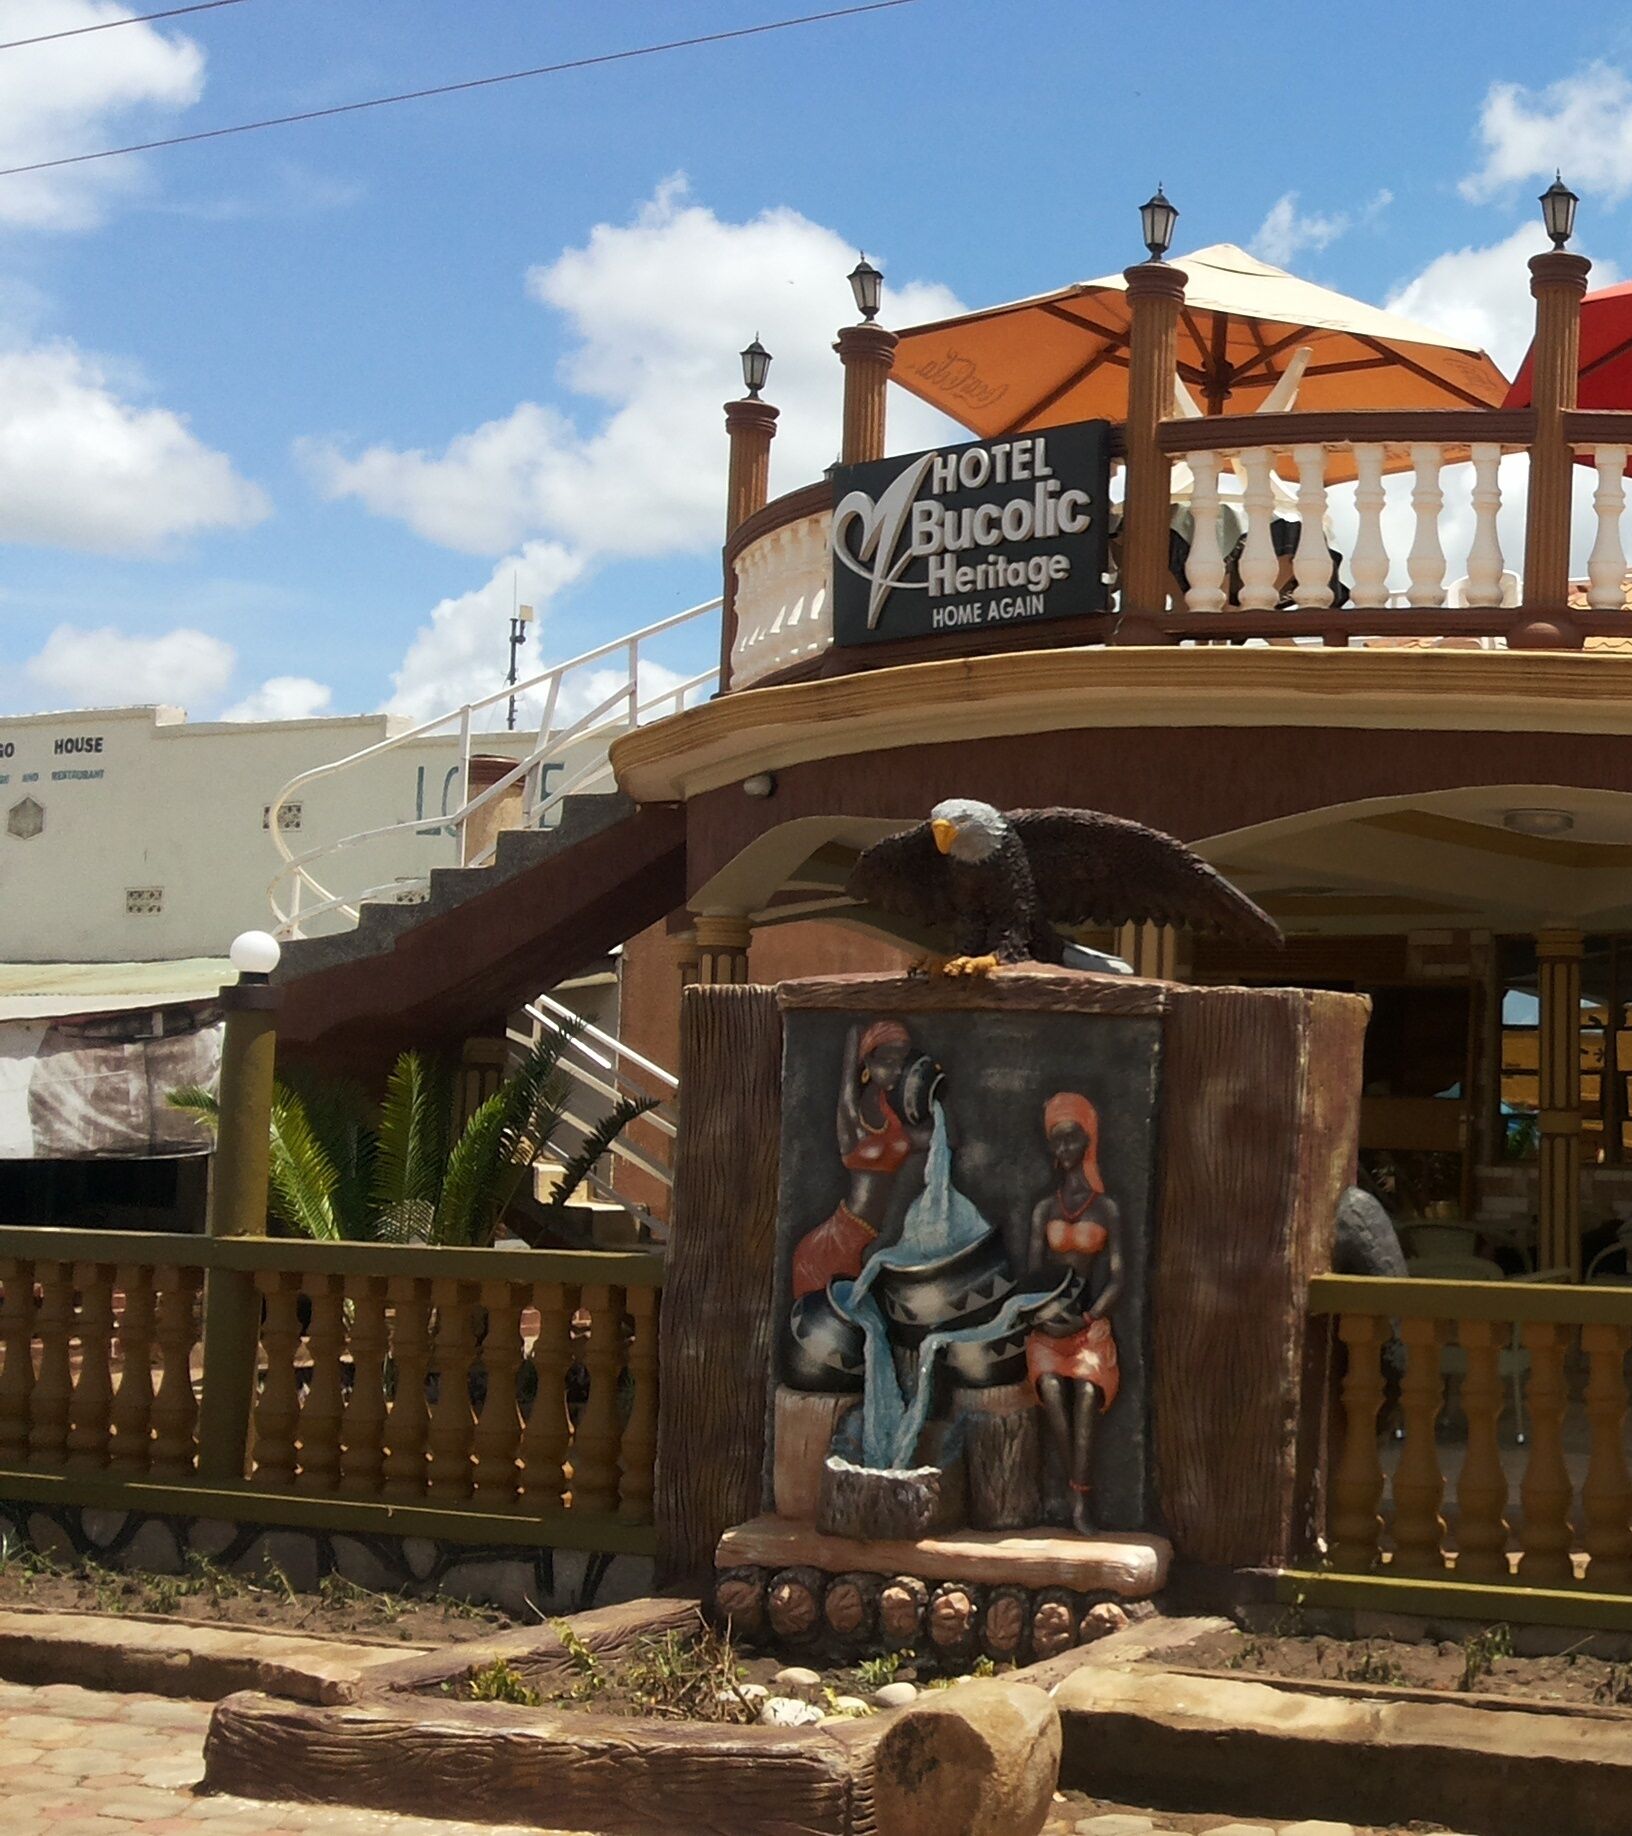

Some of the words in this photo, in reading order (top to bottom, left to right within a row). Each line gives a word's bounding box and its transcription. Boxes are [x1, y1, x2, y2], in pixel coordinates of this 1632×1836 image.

[931, 437, 1053, 495] HOTEL
[911, 479, 1092, 556] Bucolic
[928, 553, 1071, 597] Heritage
[932, 601, 983, 629] HOME
[987, 594, 1045, 622] AGAIN
[53, 737, 104, 755] HOUSE
